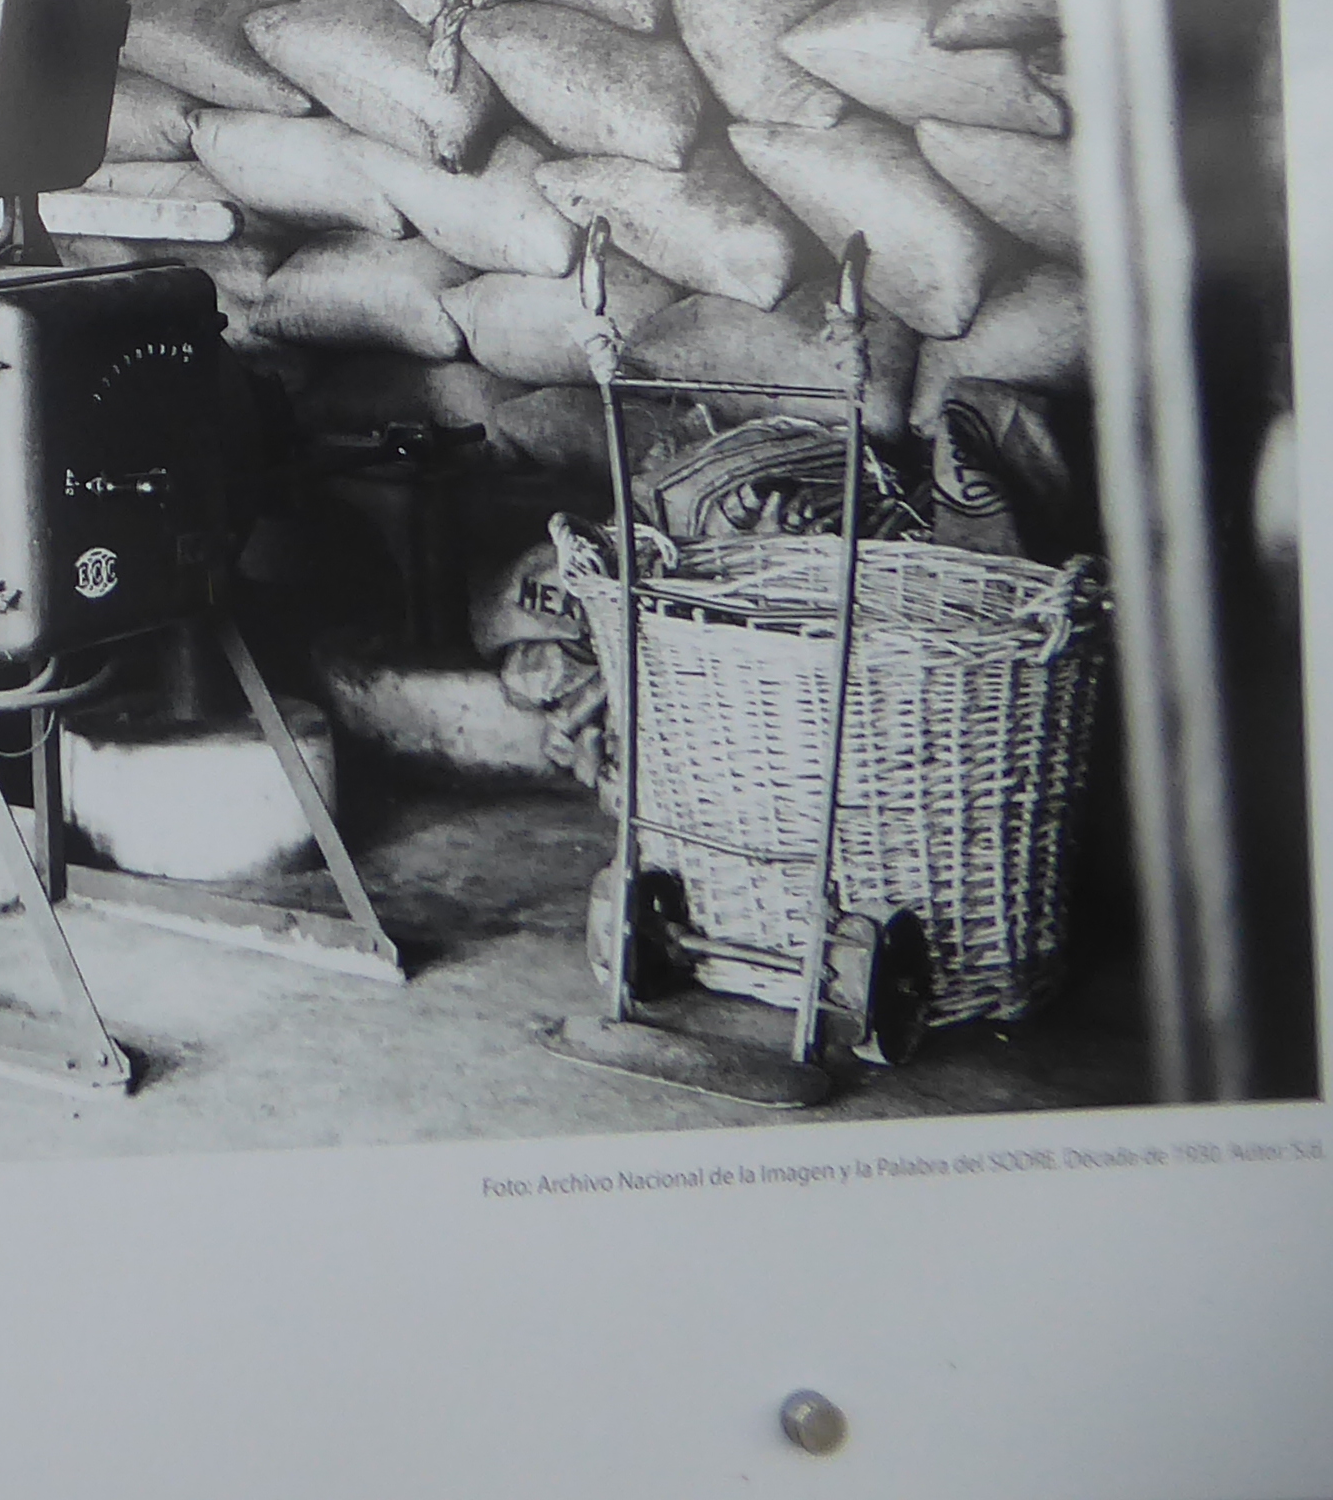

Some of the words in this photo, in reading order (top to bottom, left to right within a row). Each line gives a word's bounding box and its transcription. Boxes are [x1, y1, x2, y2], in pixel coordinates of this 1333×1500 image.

[481, 1175, 532, 1198] Foto:
[536, 1173, 614, 1195] Archivo
[618, 1166, 705, 1191] Nacional
[709, 1165, 735, 1187] de
[738, 1164, 757, 1184] la
[760, 1163, 834, 1187] Imagen
[838, 1163, 851, 1185] y
[855, 1158, 874, 1179] la
